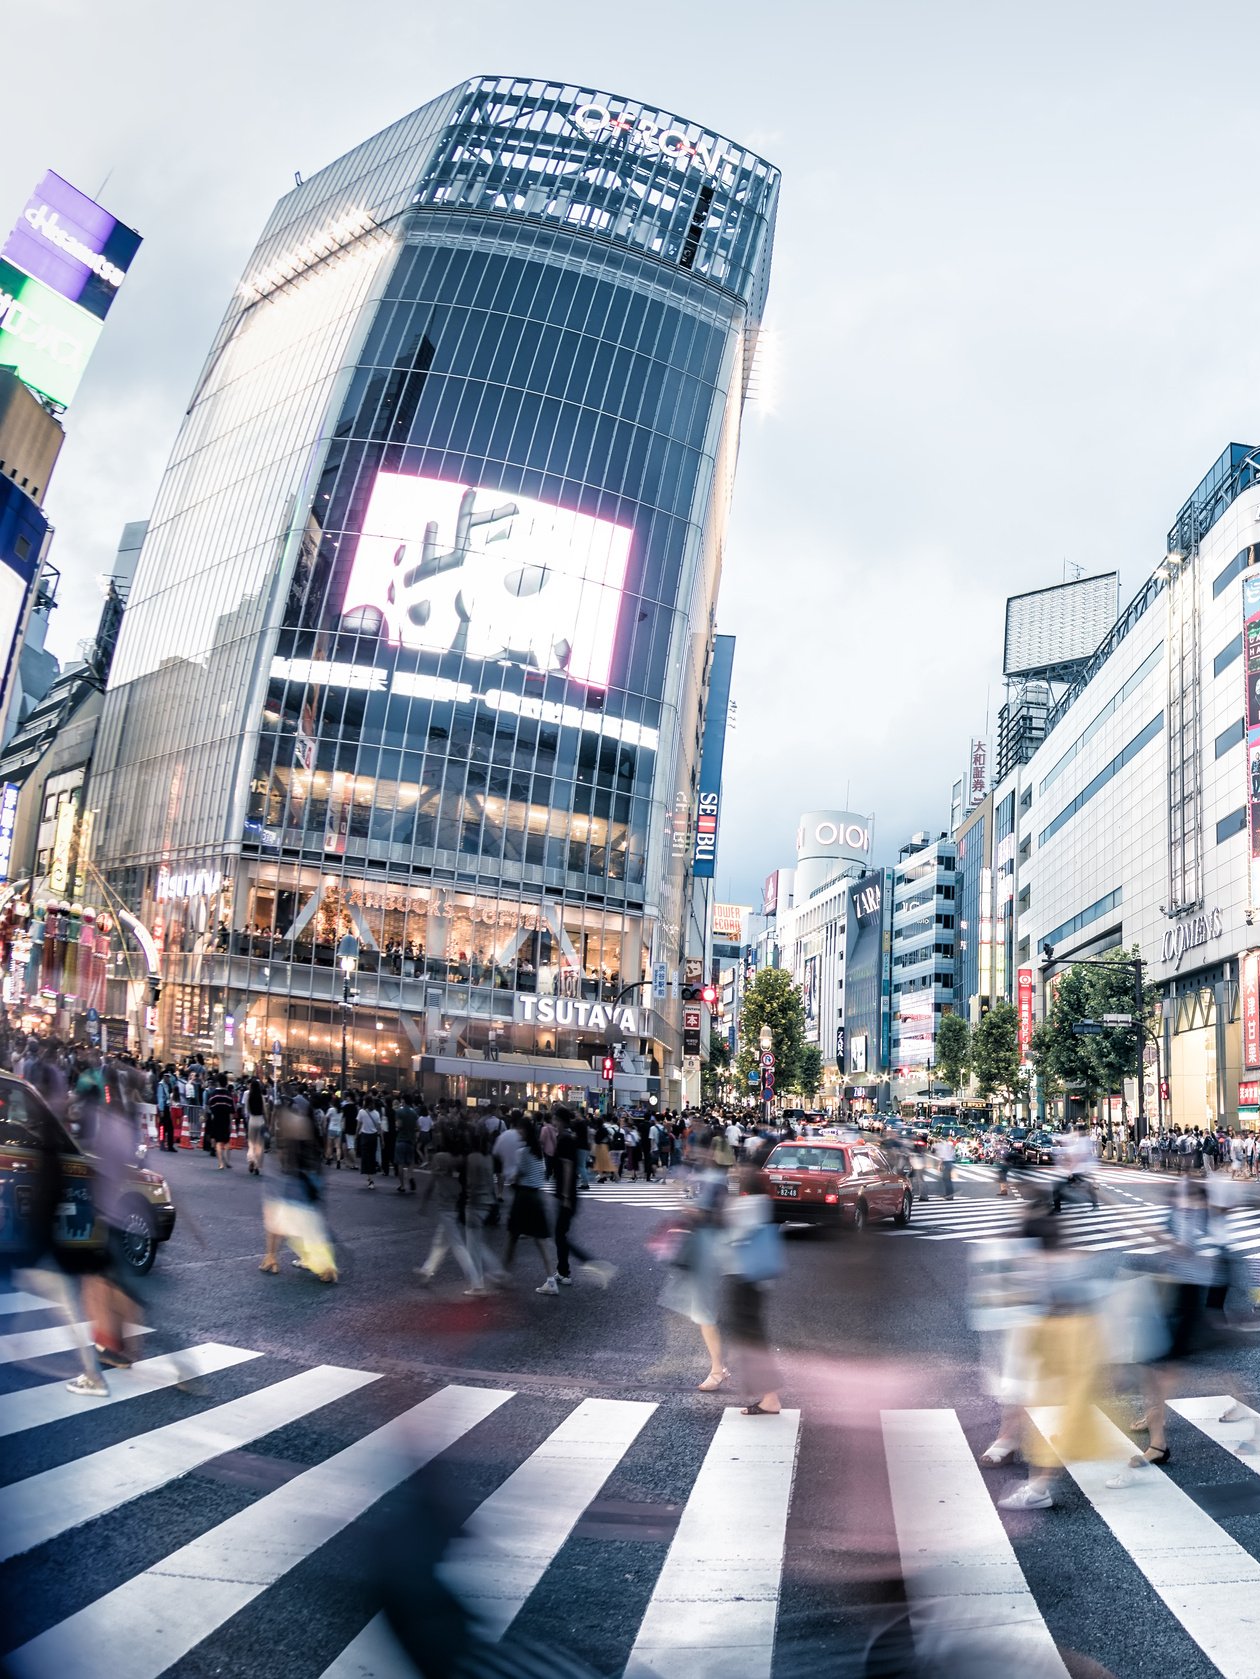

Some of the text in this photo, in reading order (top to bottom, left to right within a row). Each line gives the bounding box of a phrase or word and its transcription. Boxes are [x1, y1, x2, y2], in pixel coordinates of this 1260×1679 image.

[972, 740, 986, 793] 大和証券
[696, 793, 718, 860] SEIBU
[324, 886, 455, 919] STARBUCKS
[853, 884, 880, 919] ZARA
[519, 995, 636, 1032] TSUTAYA
[687, 1014, 698, 1026] 本
